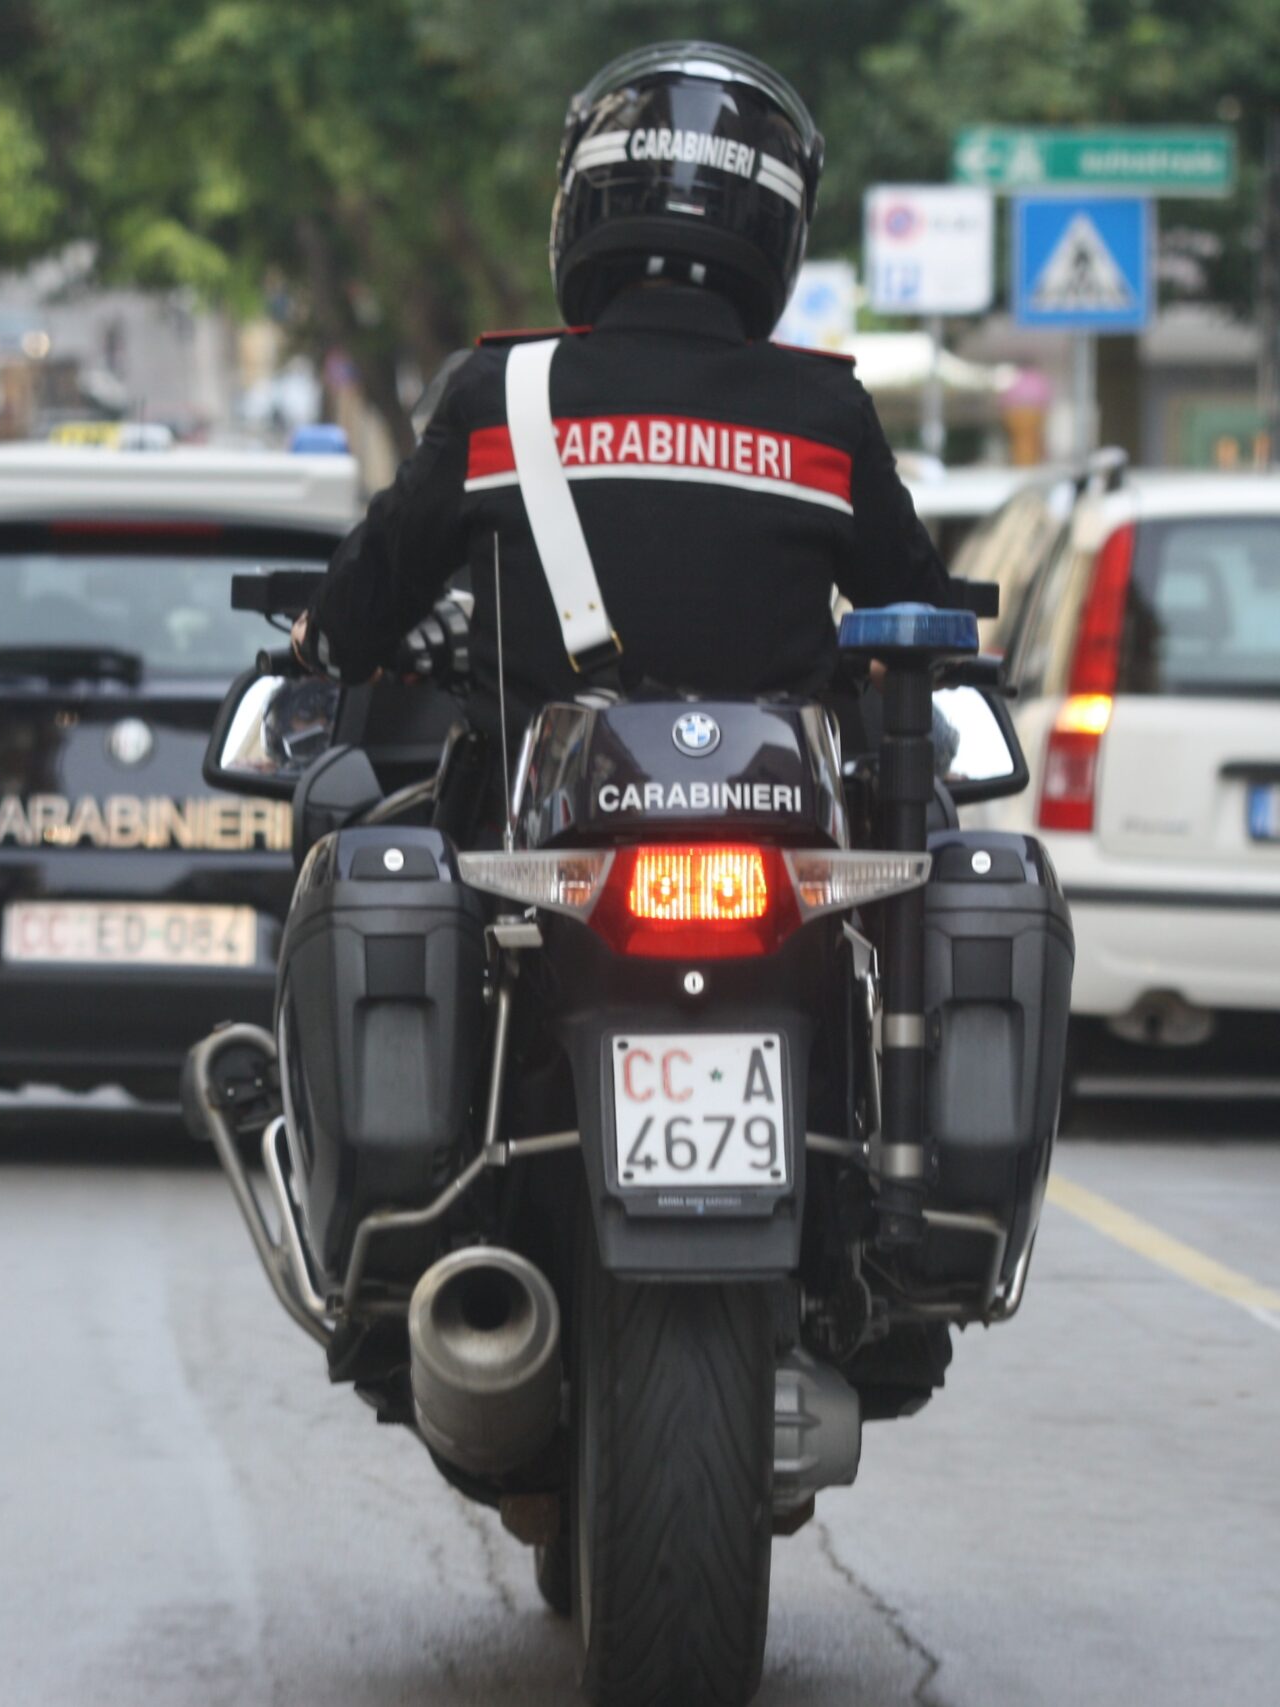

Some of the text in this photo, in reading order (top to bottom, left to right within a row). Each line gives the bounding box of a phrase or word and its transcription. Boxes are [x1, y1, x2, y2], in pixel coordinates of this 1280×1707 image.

[630, 128, 755, 179] CARABINIERI
[551, 420, 792, 480] ARABINIERI
[598, 782, 802, 812] CARABINIERI
[21, 908, 69, 952] CC
[623, 1047, 775, 1103] CC A
[626, 1116, 778, 1172] 4679
